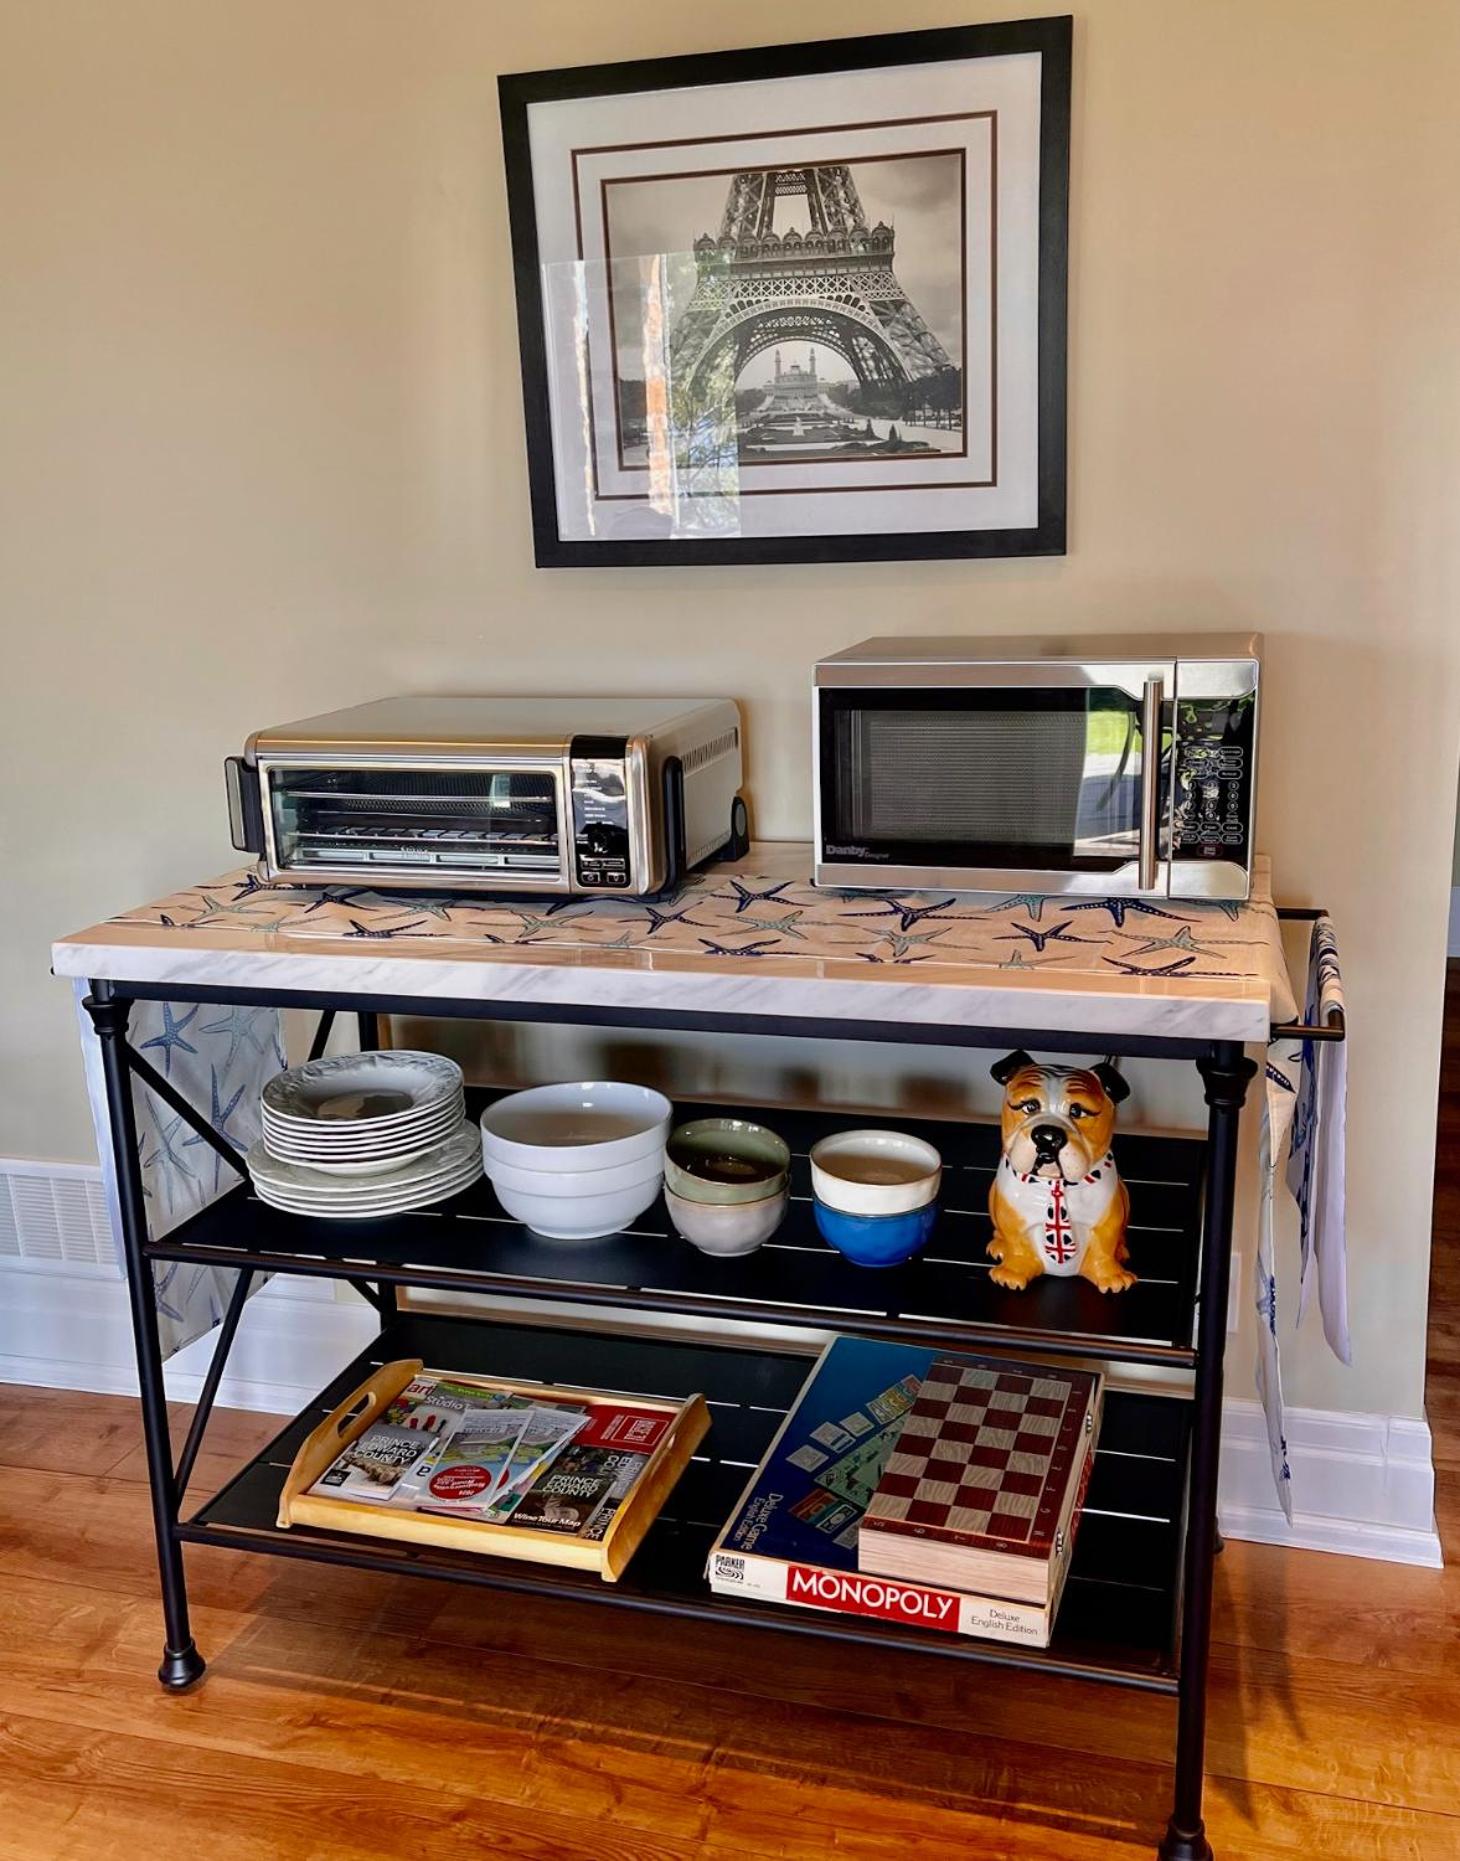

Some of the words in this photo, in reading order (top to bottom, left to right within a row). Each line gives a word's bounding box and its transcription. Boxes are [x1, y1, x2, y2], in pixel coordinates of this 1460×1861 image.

[826, 844, 866, 858] Danby
[361, 1441, 417, 1457] EDWARD
[370, 1435, 419, 1449] PRINCE
[354, 1450, 409, 1465] COUNTY
[546, 1480, 599, 1492] EDWARD
[549, 1474, 603, 1485] PRINCE
[542, 1485, 593, 1498] COUNTY
[757, 1493, 784, 1523] Deluxe
[514, 1513, 538, 1521] Wine
[538, 1515, 557, 1523] Tour
[559, 1518, 581, 1527] Map
[741, 1523, 768, 1550] Game
[715, 1554, 745, 1570] PARKER
[792, 1569, 954, 1620] MONOPOLY
[989, 1608, 1021, 1622] Deluxe
[971, 1616, 1006, 1631] English
[1006, 1621, 1038, 1636] Edition
